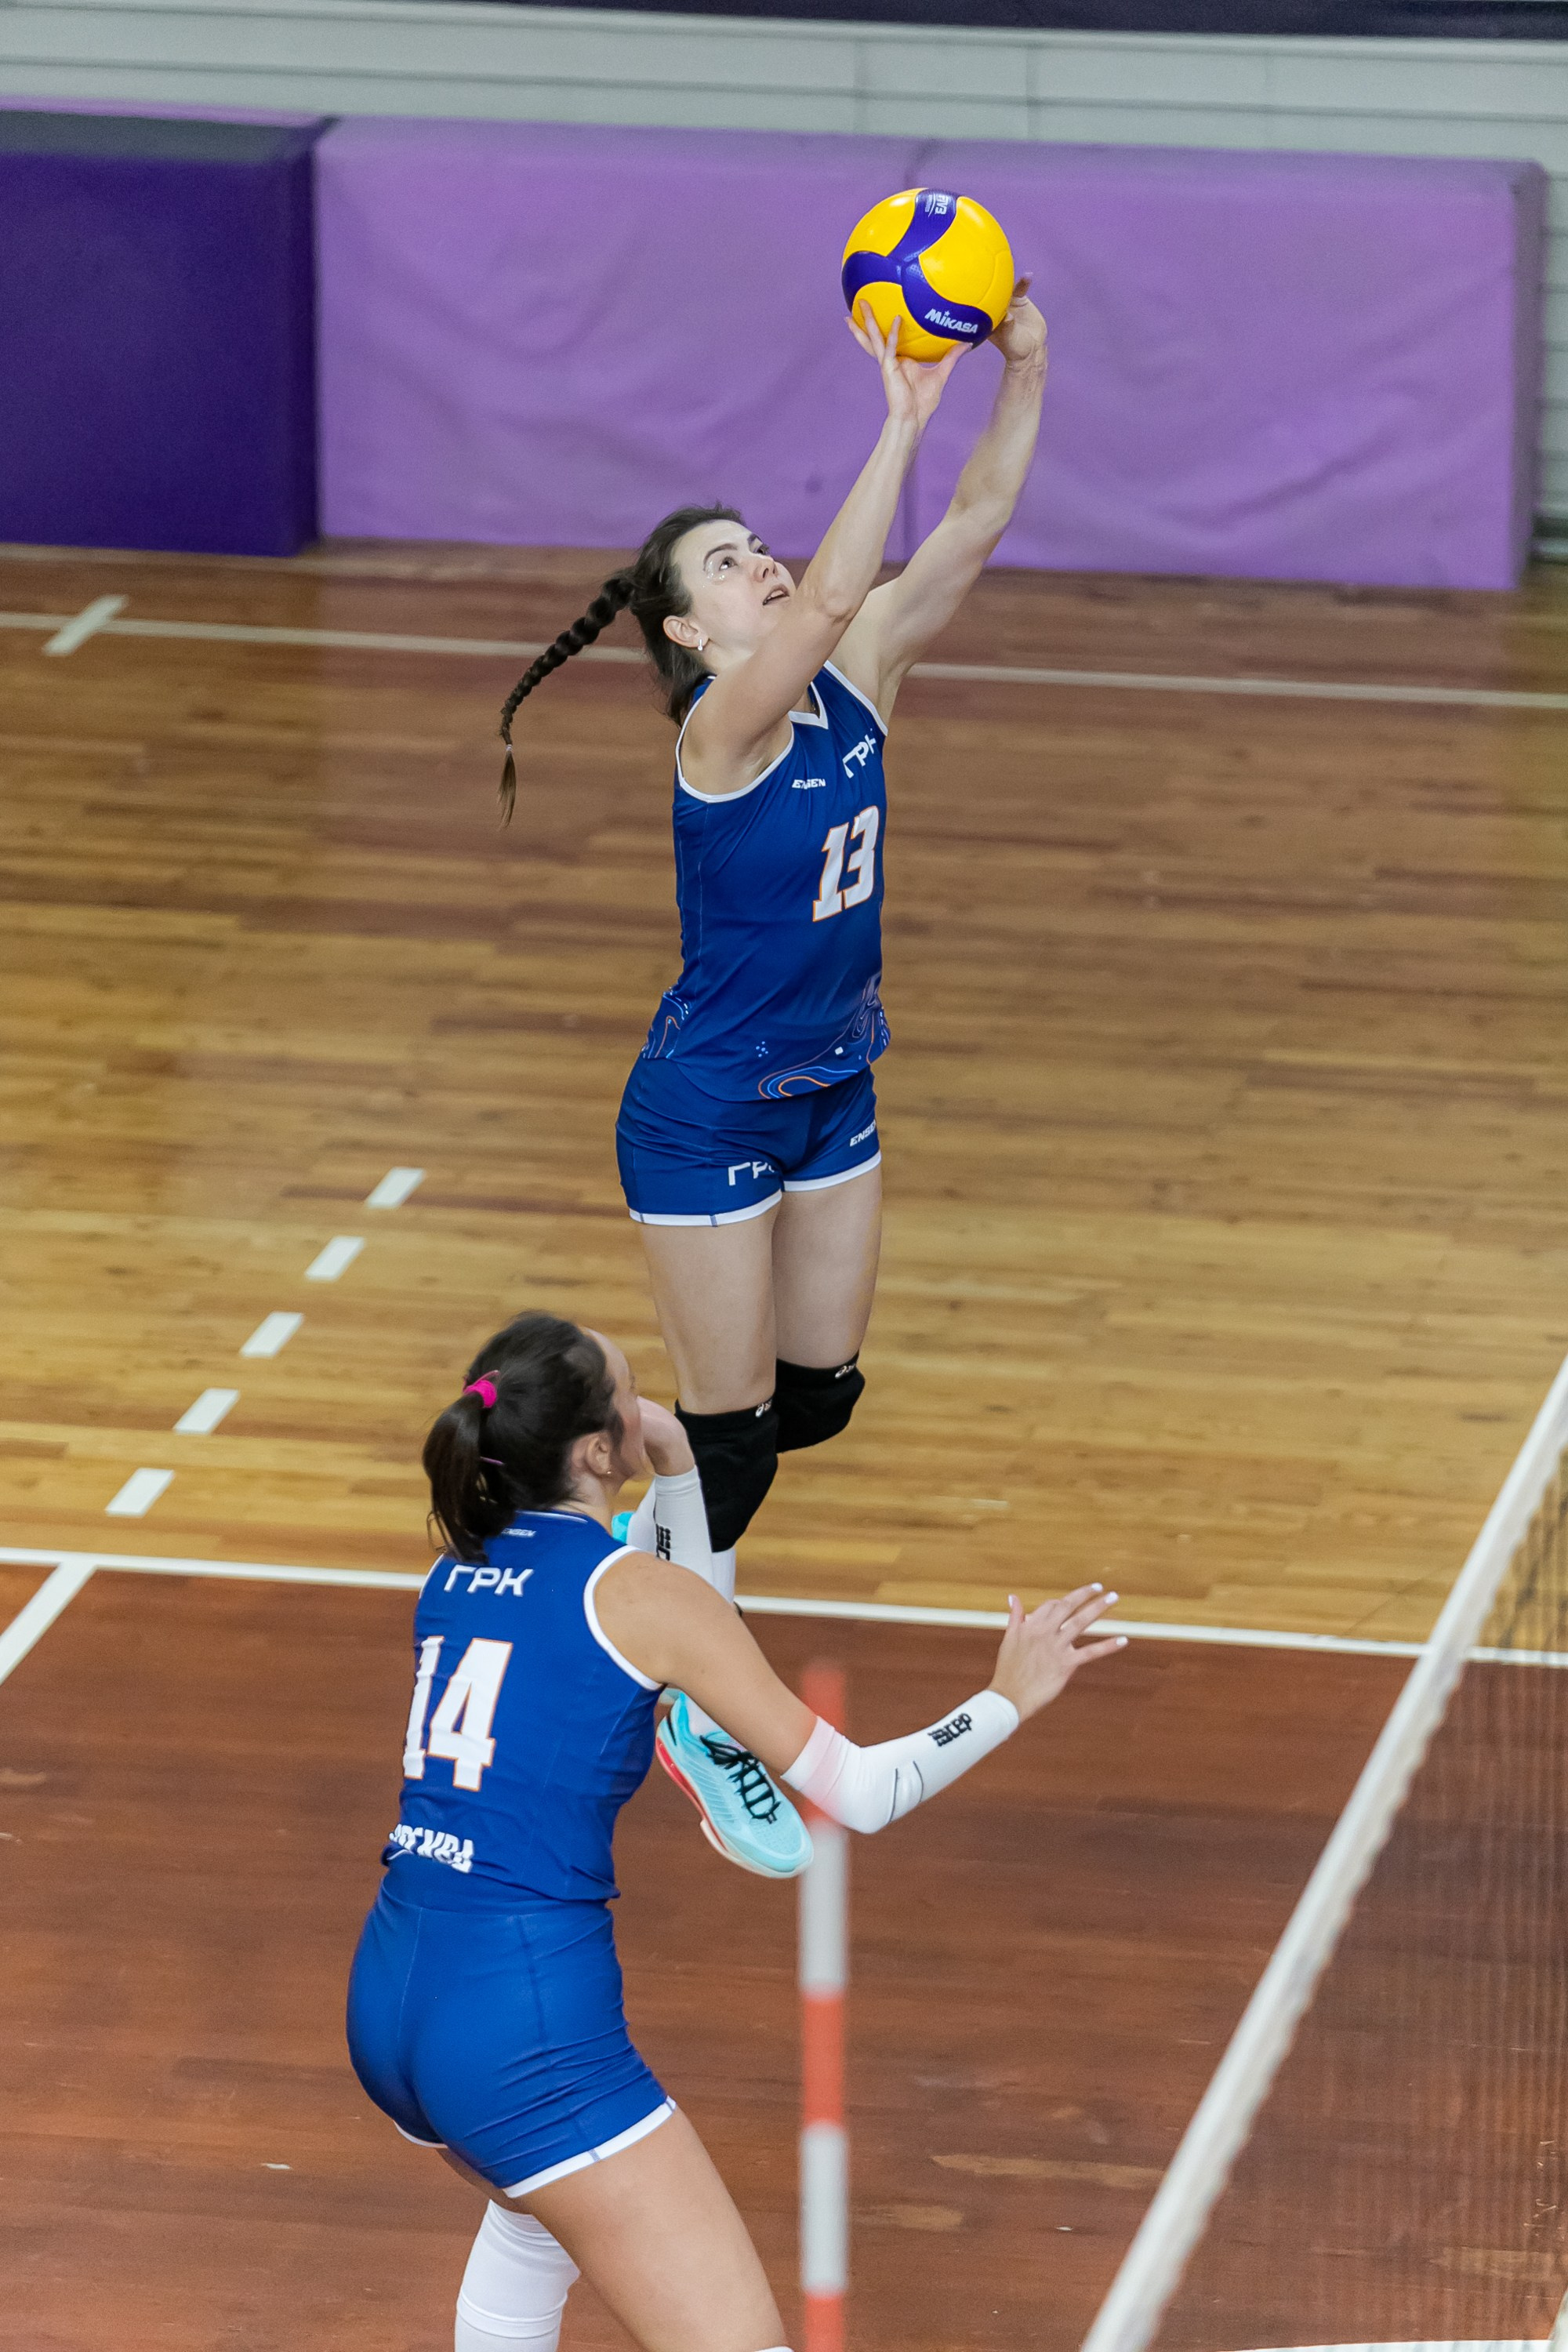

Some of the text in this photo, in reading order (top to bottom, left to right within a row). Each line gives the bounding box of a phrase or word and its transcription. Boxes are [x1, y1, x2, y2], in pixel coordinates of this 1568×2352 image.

[812, 805, 879, 922] 13
[728, 1161, 775, 1185] ГР
[444, 1564, 534, 1597] ГРК
[404, 1635, 514, 1791] 14
